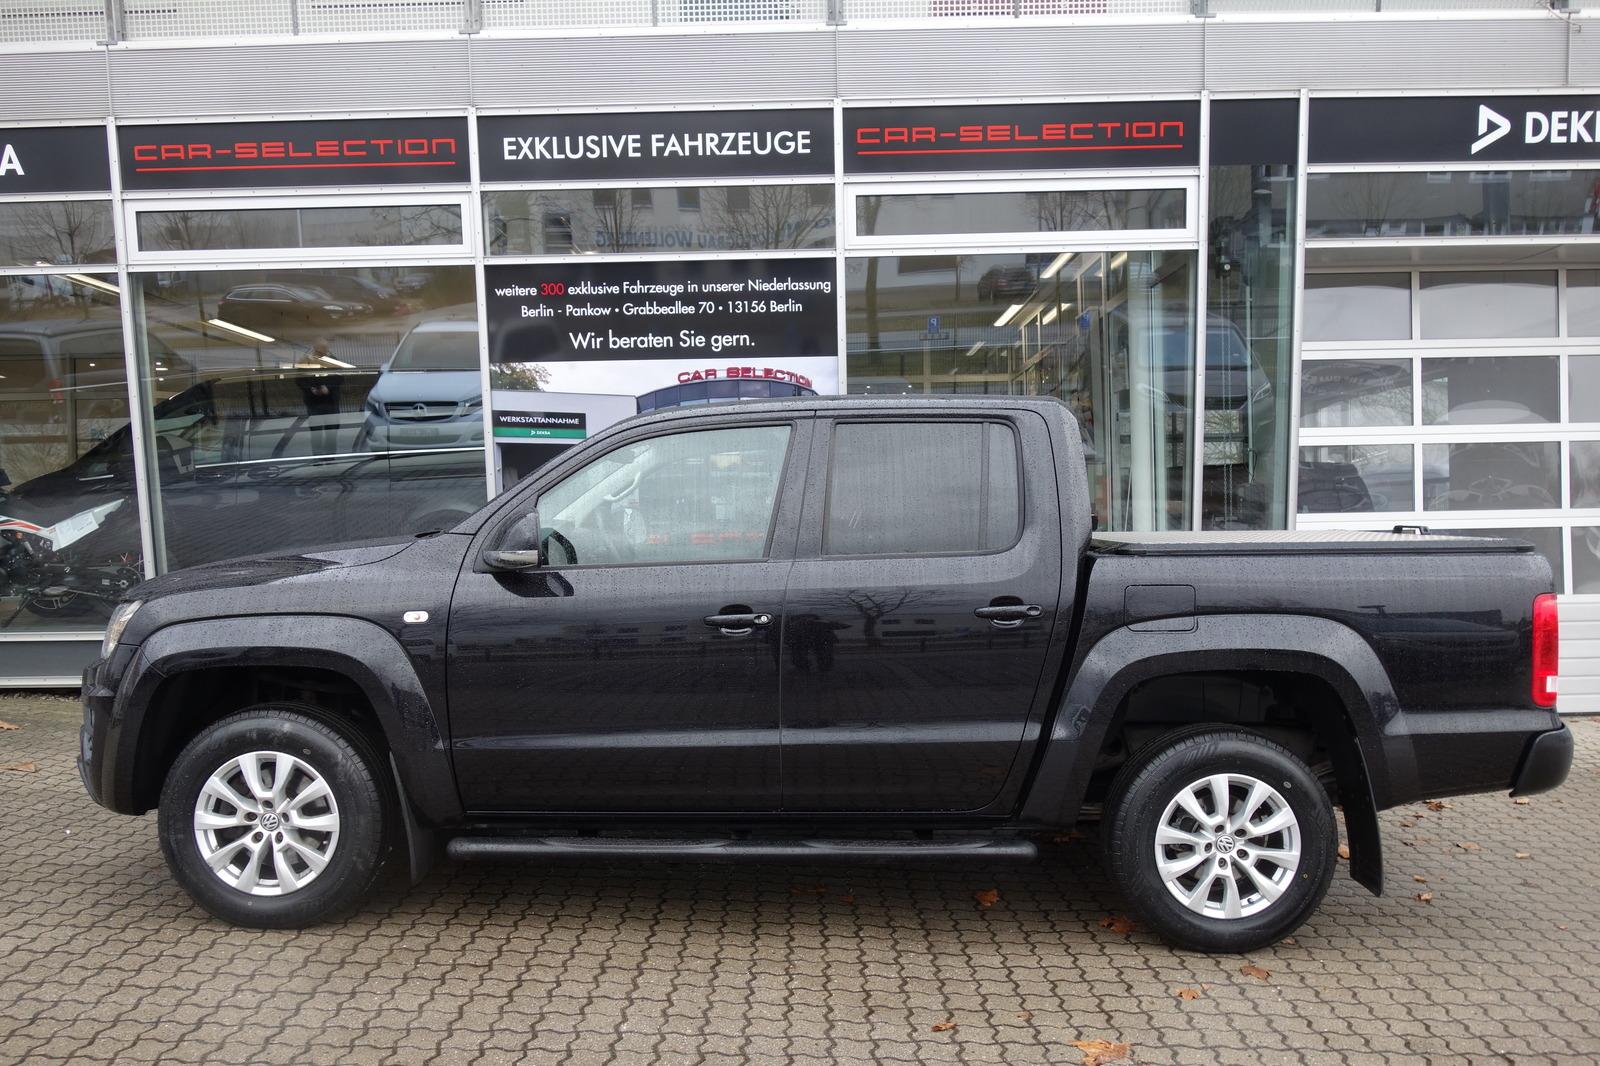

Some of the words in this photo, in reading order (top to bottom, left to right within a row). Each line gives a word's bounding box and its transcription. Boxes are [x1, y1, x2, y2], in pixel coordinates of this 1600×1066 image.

[855, 120, 1184, 145] CAR-SELECTION
[133, 137, 456, 162] CAR-SELECTION
[502, 134, 642, 161] EXKLUSIVE
[650, 130, 811, 157] FAHRZEUGE
[494, 284, 538, 297] weitere
[540, 282, 565, 296] 300
[567, 280, 620, 296] exklusive
[622, 279, 685, 297] Fahrzeuge
[687, 280, 699, 294] in
[701, 282, 745, 294] unserer
[747, 277, 832, 296] Niederlassung
[520, 303, 554, 318] Berlin
[565, 302, 612, 317] Pankow
[622, 300, 696, 316] Grabbeallee
[698, 301, 715, 314] 70
[727, 300, 767, 314] 13156
[769, 298, 803, 313] Berlin
[568, 331, 604, 350] Wir
[608, 328, 674, 349] beraten
[679, 329, 706, 348] Sie
[710, 333, 756, 353] gern.
[677, 368, 717, 384] CAR
[726, 366, 813, 388] SELECTION
[499, 415, 580, 425] WERKSTATTANNAHME
